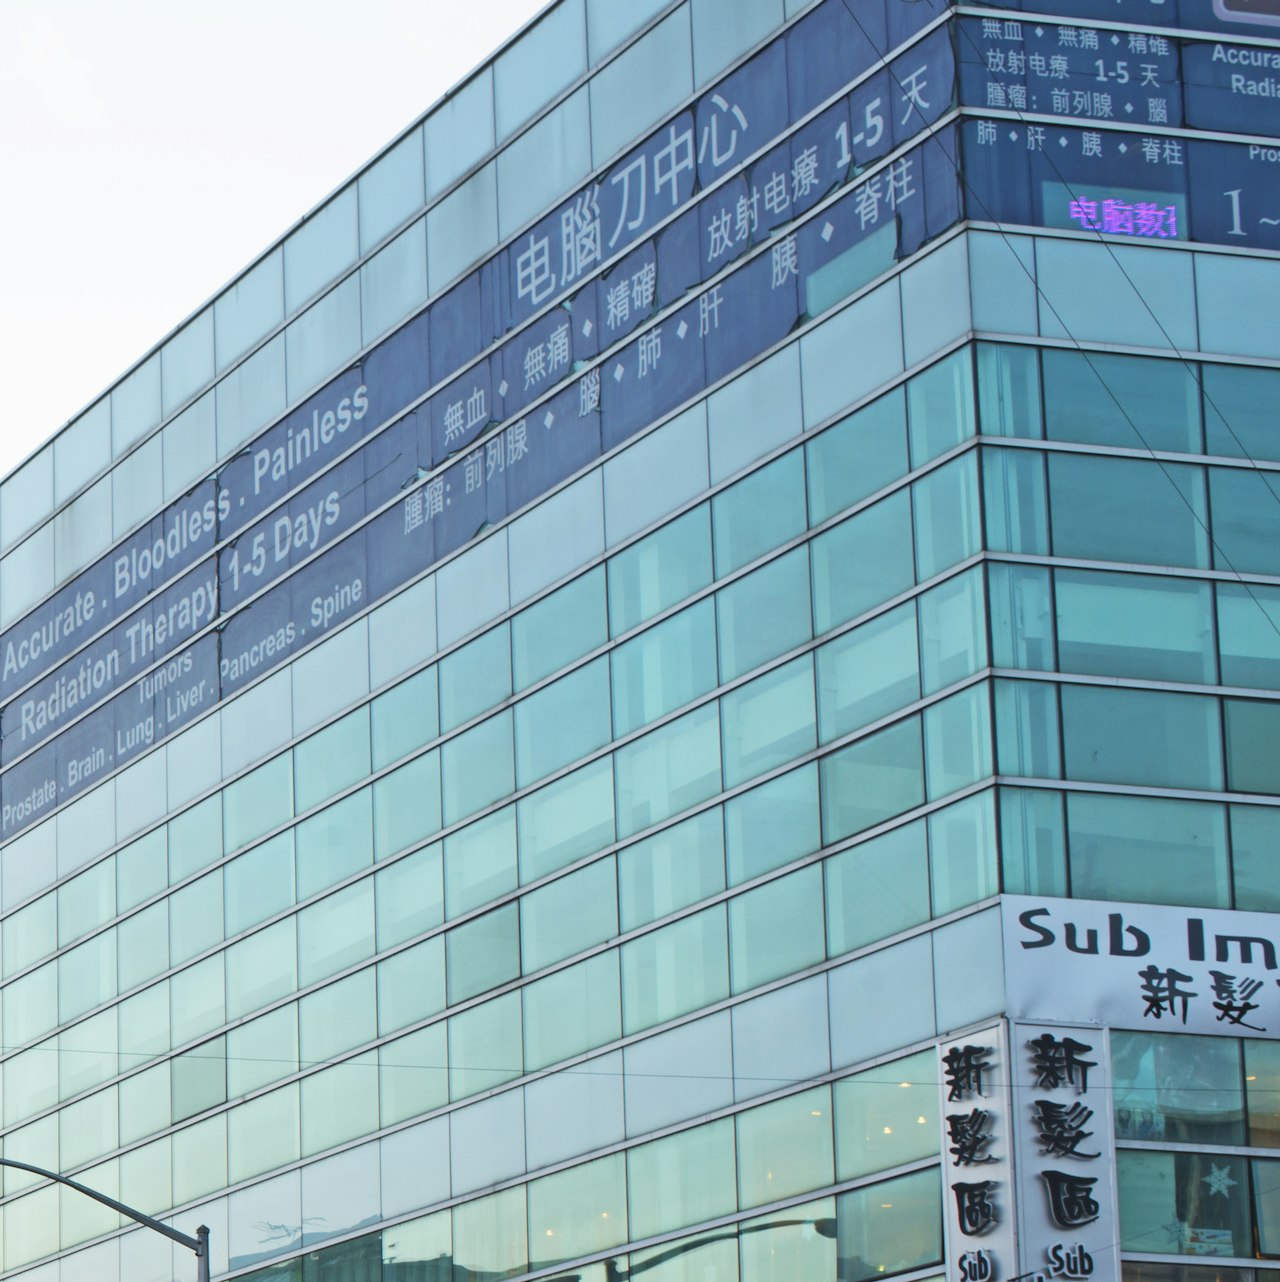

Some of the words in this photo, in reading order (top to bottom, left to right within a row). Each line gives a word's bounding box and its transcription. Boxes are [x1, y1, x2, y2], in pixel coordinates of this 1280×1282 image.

[834, 99, 885, 170] 1-5
[900, 65, 931, 127] 天
[1094, 60, 1130, 84] 1-5
[1140, 63, 1160, 88] 天
[977, 120, 997, 146] 肺
[1027, 127, 1046, 152] 肝
[1141, 138, 1184, 166] 脊柱
[2, 587, 96, 682] Accurate
[114, 486, 231, 600] Bloodless
[253, 382, 370, 497] Painless
[20, 646, 120, 742] Radiation
[126, 583, 219, 666] Therapy
[228, 537, 268, 594] 1-5
[274, 489, 342, 566] Days
[1, 779, 58, 833] Prostate
[67, 746, 106, 796] Brain
[116, 715, 155, 757] Lung
[166, 673, 206, 725] Liver
[219, 622, 296, 686] Pancreas
[310, 576, 363, 630] Spine
[138, 649, 194, 705] Tumors
[1018, 906, 1152, 958] Sub
[942, 1045, 1001, 1237] 新髮區
[1028, 1033, 1102, 1230] 新髮區
[1047, 1243, 1095, 1279] Sub
